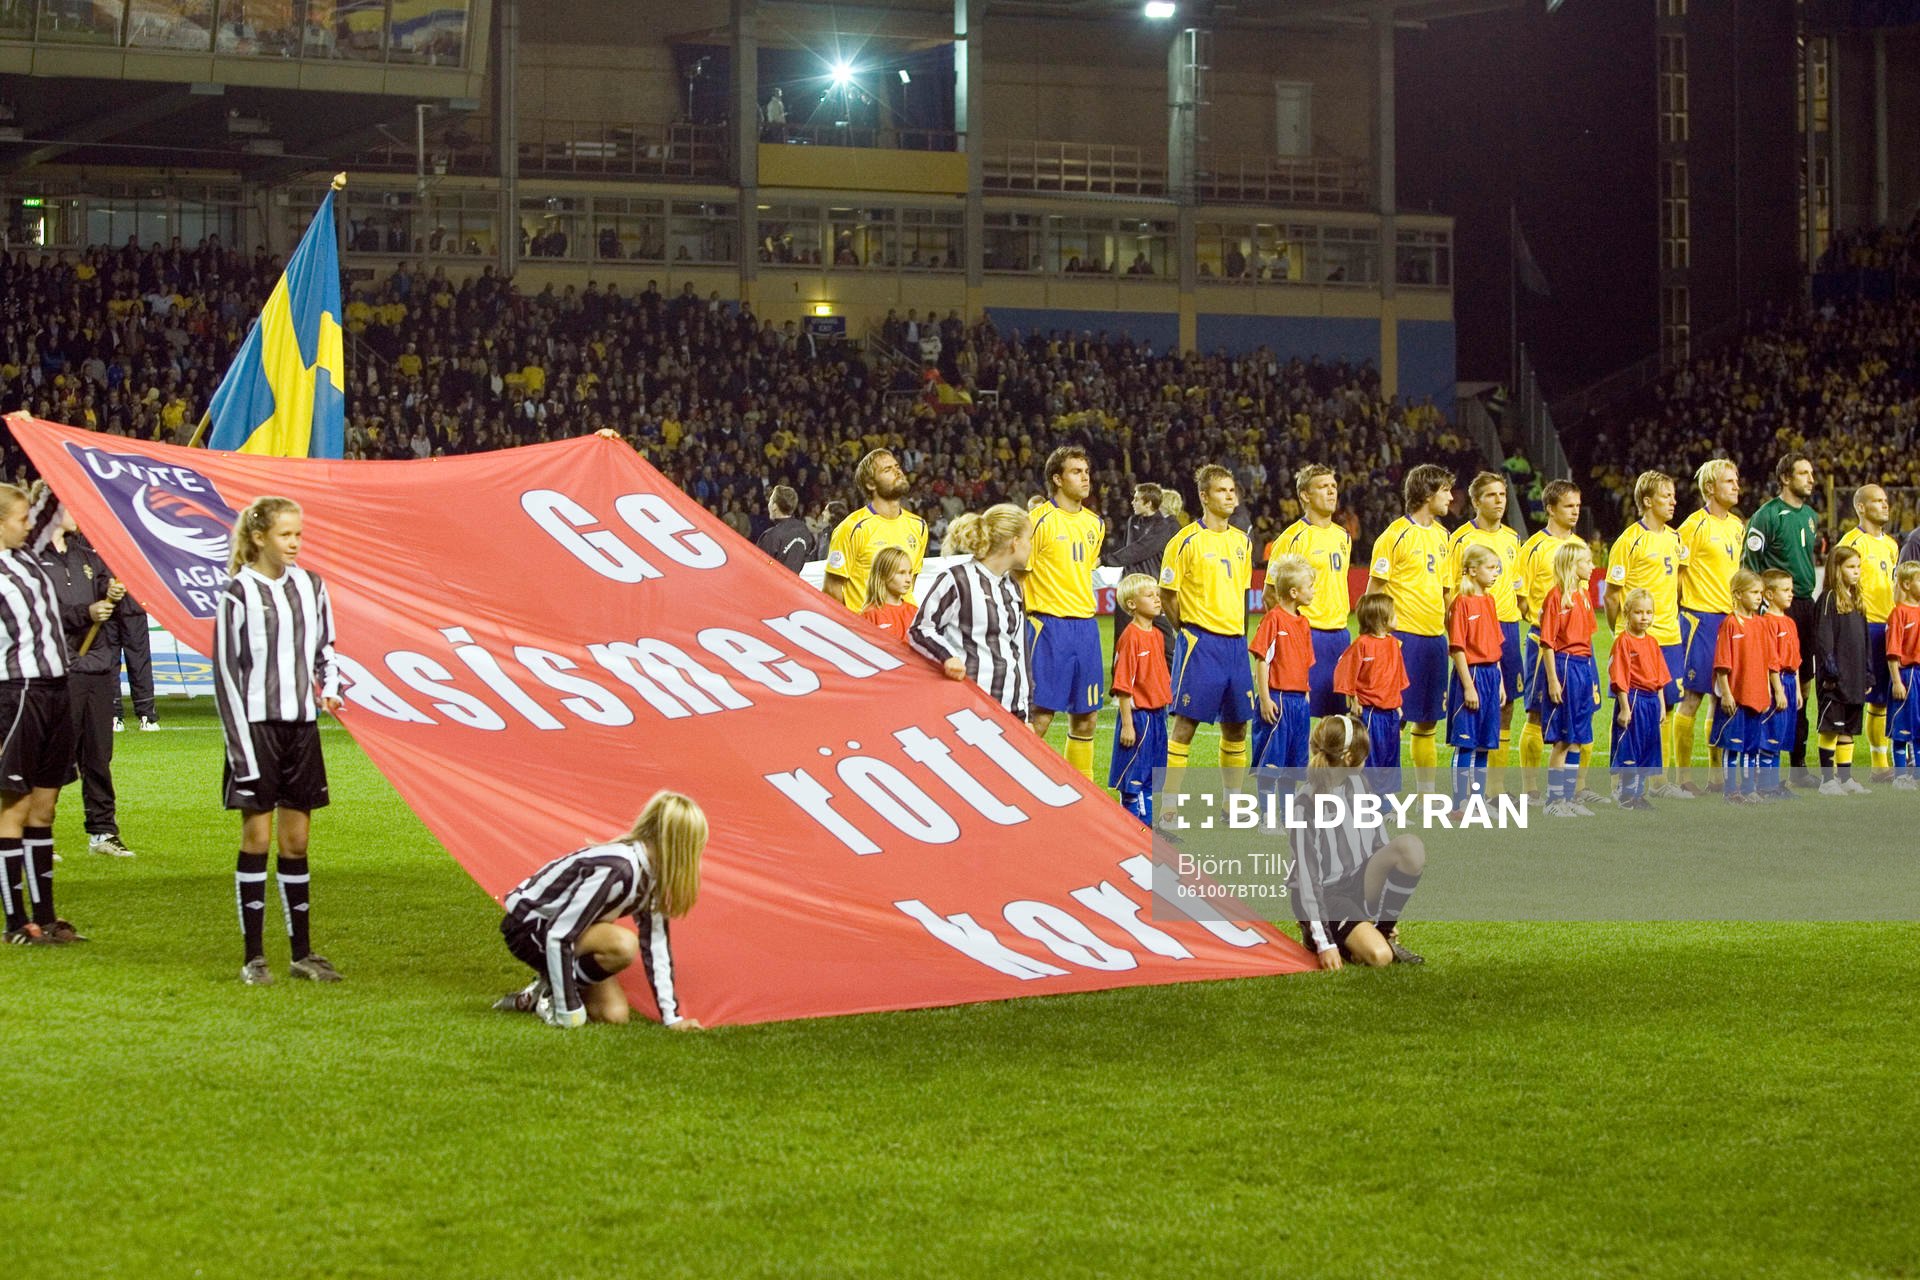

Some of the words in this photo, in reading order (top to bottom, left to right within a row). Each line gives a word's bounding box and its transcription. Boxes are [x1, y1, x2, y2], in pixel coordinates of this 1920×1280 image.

[519, 488, 729, 585] Ge
[1800, 527, 1807, 548] 1
[1072, 541, 1084, 562] 11
[1328, 551, 1342, 573] 10
[1725, 543, 1735, 561] 4
[1220, 557, 1233, 579] 7
[1426, 553, 1436, 574] 2
[1663, 556, 1674, 576] 5
[175, 565, 232, 588] AGA
[334, 609, 906, 732] asismen
[1086, 682, 1100, 708] 11
[763, 707, 1084, 856] rött
[892, 854, 1269, 981] kort
